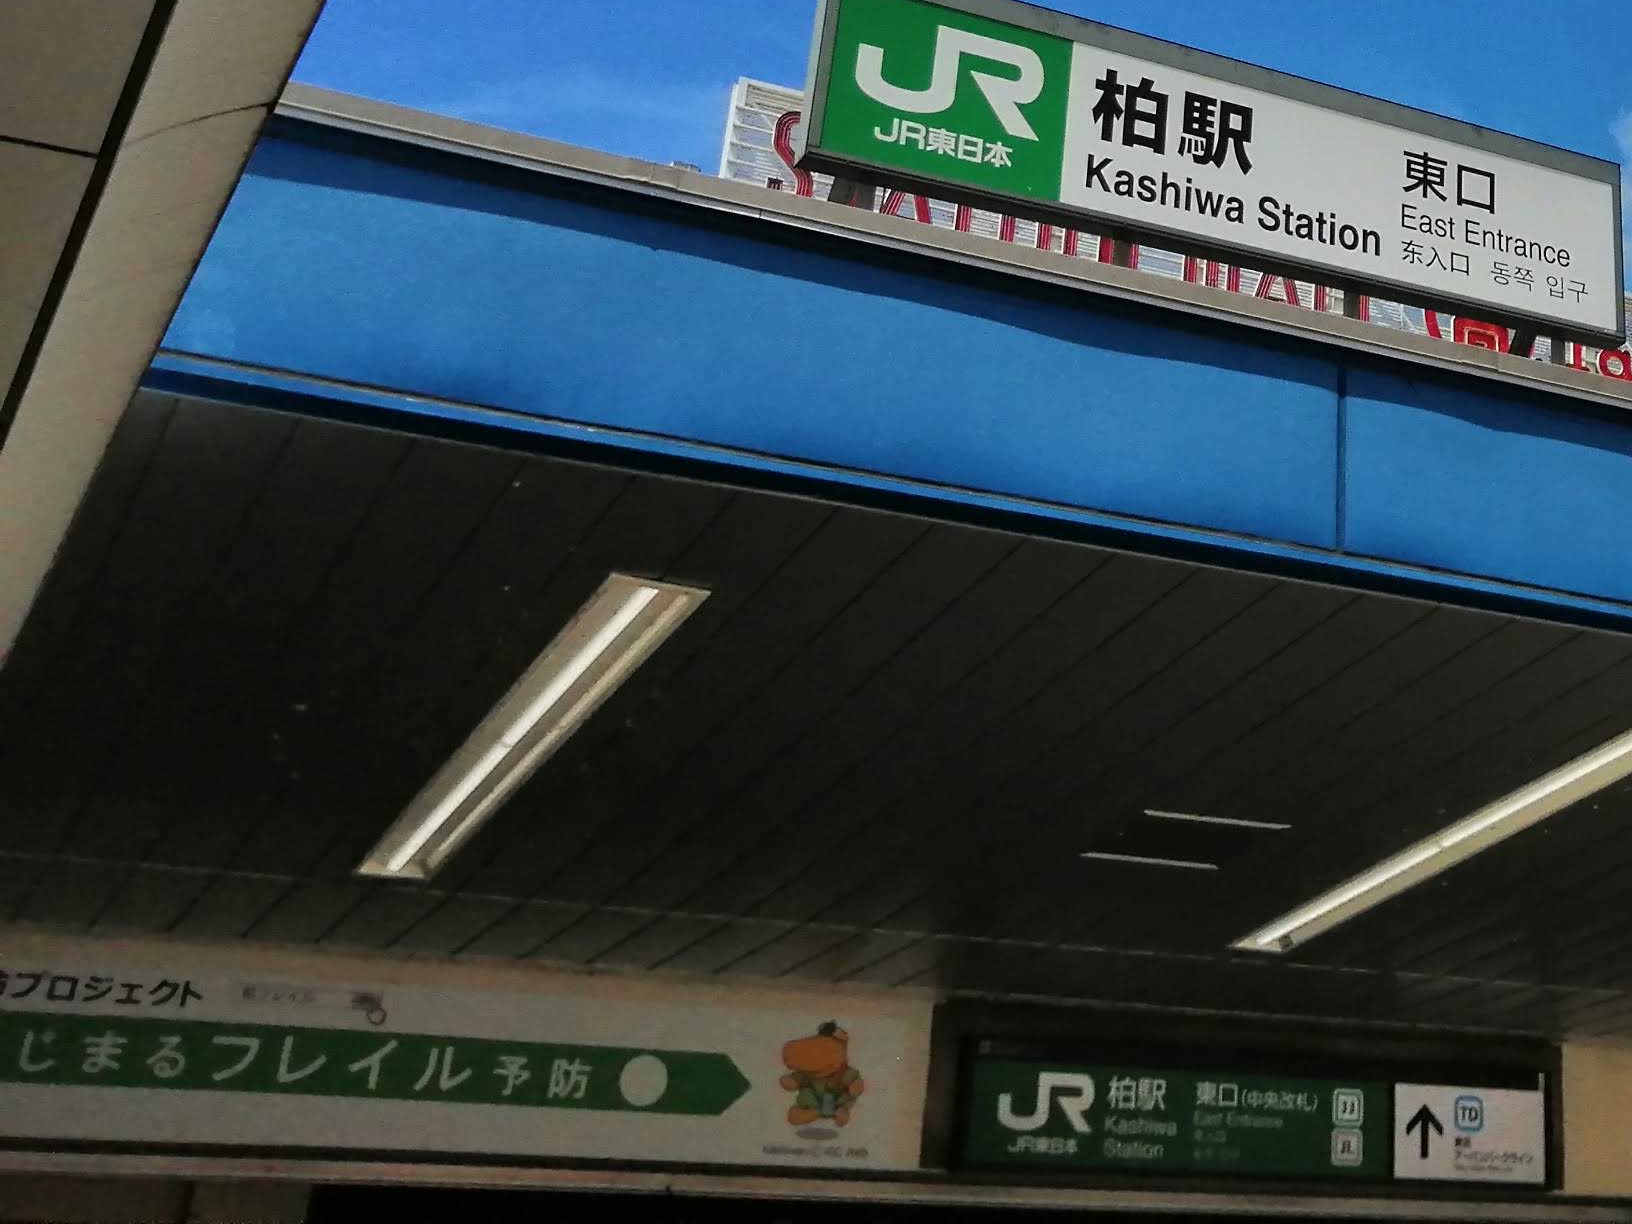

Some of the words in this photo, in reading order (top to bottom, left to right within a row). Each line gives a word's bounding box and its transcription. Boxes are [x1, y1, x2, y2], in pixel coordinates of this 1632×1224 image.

[854, 24, 1045, 142] JR
[873, 116, 1014, 169] JR東日本
[1091, 67, 1254, 176] 柏駅
[1085, 152, 1245, 225] Kashiwa
[1256, 195, 1382, 257] Station
[1401, 149, 1497, 215] 東口
[1400, 203, 1456, 242] East
[1464, 220, 1571, 269] Entrance
[1400, 239, 1471, 277] 东入口
[1489, 260, 1535, 292] 동쪽
[1544, 275, 1590, 305] 입구
[996, 1071, 1096, 1134] JR
[1106, 1075, 1168, 1112] 柏駅
[1459, 1106, 1478, 1122] TD
[1103, 1115, 1178, 1138] Kashiwa
[1103, 1137, 1165, 1160] Station
